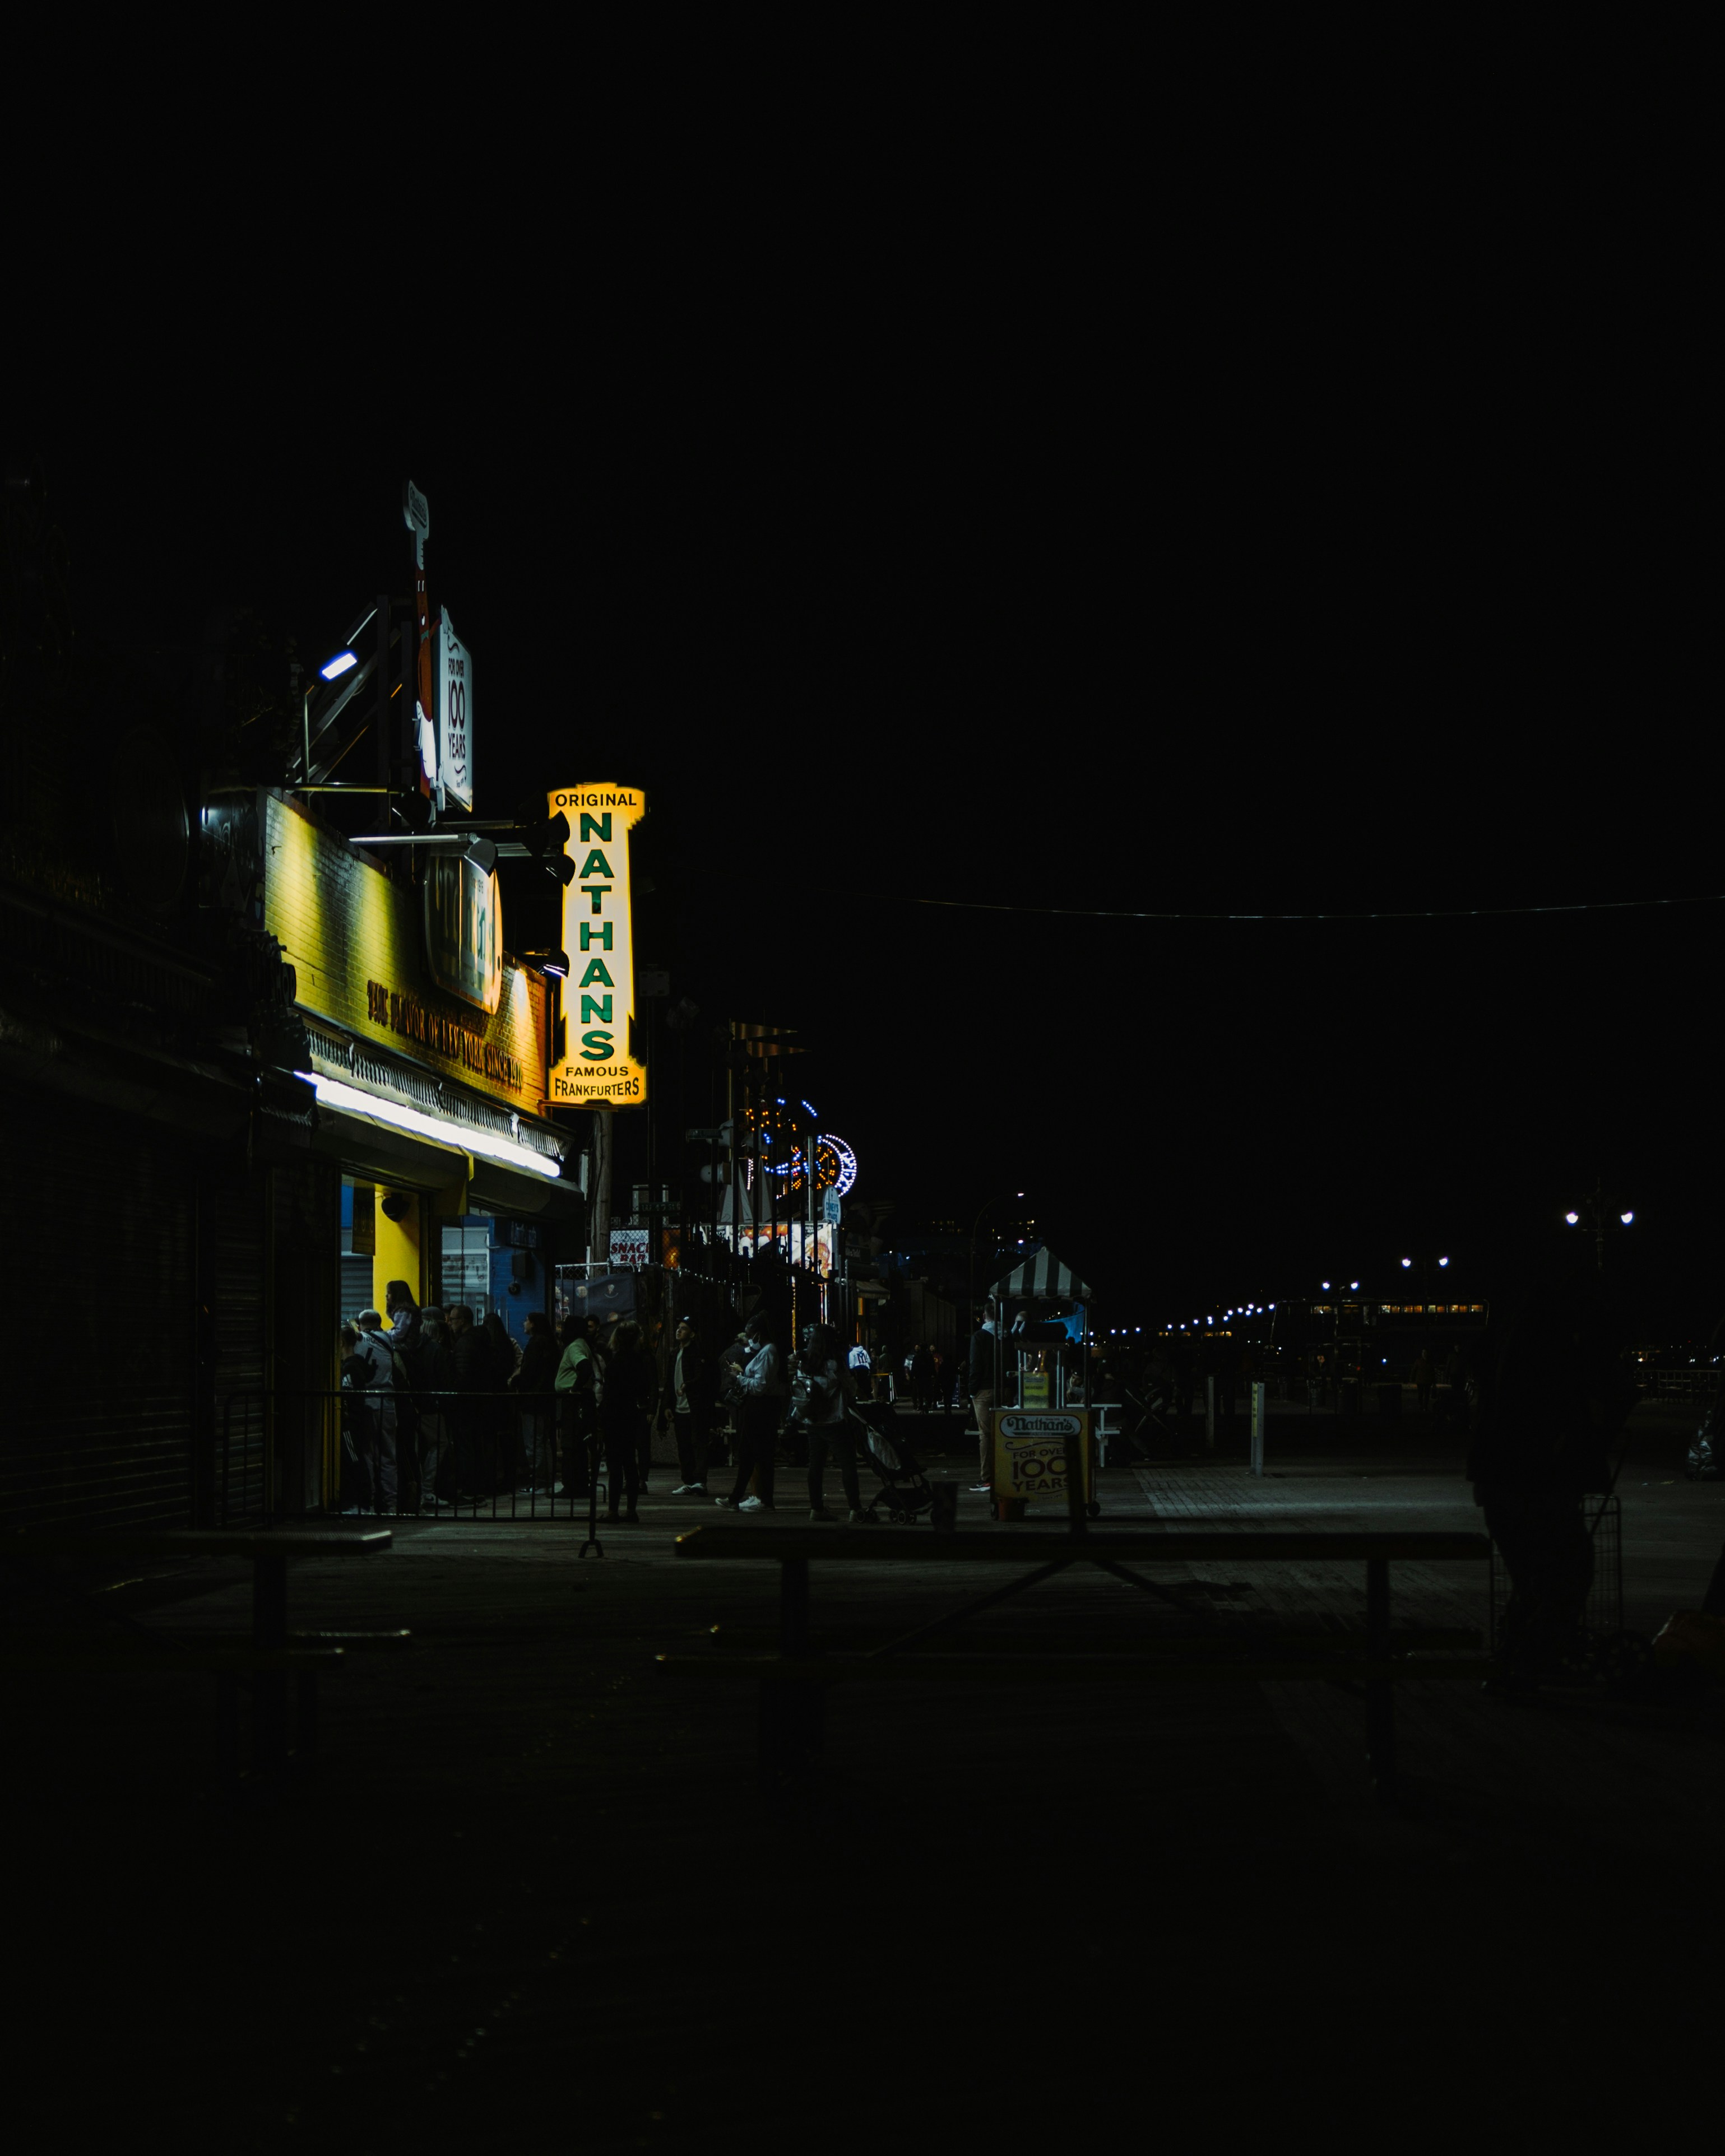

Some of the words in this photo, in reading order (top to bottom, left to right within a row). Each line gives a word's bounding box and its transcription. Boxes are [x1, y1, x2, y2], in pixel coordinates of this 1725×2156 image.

[456, 660, 464, 677] OVER
[448, 679, 465, 729] 100
[448, 733, 466, 759] YEARS
[555, 793, 637, 807] ORIGINAL
[578, 812, 615, 1061] NATHANS
[462, 1030, 484, 1070] YORK
[486, 1042, 508, 1082] SINCE
[566, 1066, 629, 1076] FAMOUS
[555, 1077, 639, 1096] FRANKFURTERS
[1007, 1416, 1075, 1434] Nathan's
[1013, 1450, 1036, 1459] FOR
[1013, 1456, 1069, 1479] 100
